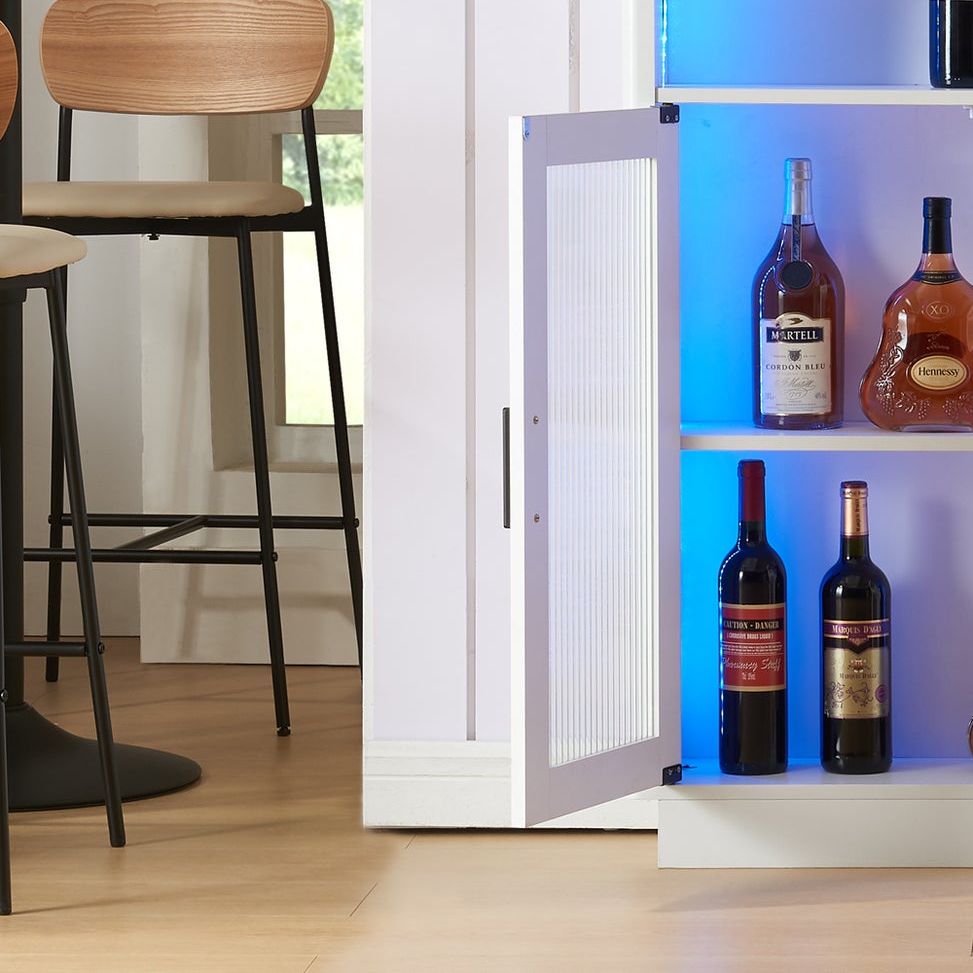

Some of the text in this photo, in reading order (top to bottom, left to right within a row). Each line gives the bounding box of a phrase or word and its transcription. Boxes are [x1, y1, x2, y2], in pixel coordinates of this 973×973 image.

[930, 305, 950, 315] XO
[771, 330, 818, 340] MARTELL
[918, 367, 959, 378] Hennessy
[755, 621, 780, 629] DANGER
